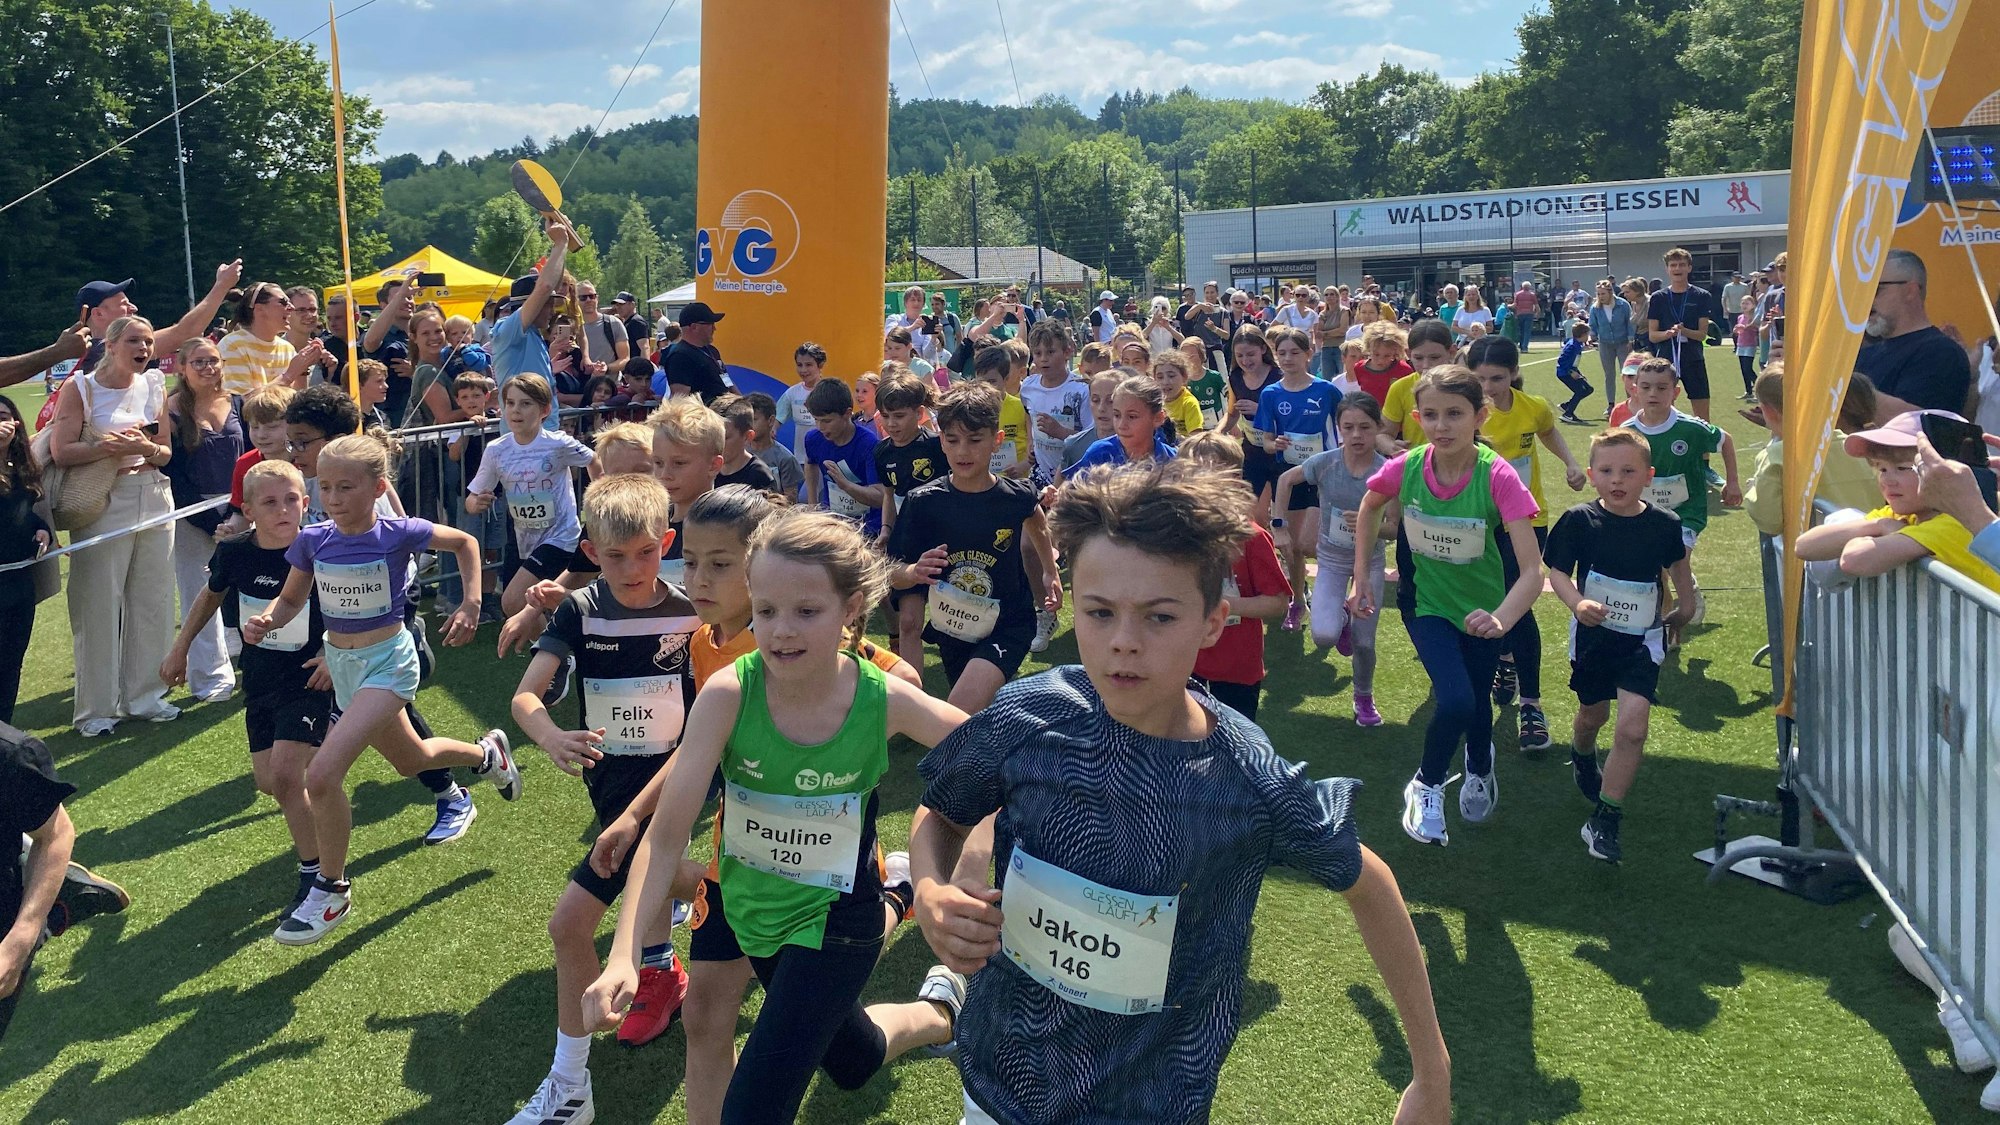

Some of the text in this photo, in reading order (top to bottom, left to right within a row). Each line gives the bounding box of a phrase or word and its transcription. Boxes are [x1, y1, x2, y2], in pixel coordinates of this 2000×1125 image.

[1388, 187, 1700, 225] WALDSTADION GLESSEN
[697, 227, 777, 276] GVG
[1271, 264, 1315, 273] Waldstadion
[714, 279, 787, 296] Meine Energie.
[1294, 444, 1314, 452] Clara
[1651, 488, 1672, 496] Felix
[513, 504, 547, 519] 1423
[1423, 530, 1461, 545] Luise
[1433, 545, 1450, 555] 121
[967, 550, 998, 568] GLESSEN
[320, 580, 382, 595] Weronika
[340, 598, 360, 607] 274
[1605, 595, 1638, 611] Leon
[938, 601, 980, 622] Matteo
[1610, 611, 1629, 622] 273
[946, 618, 964, 630] 418
[586, 641, 619, 652] uhlsport
[612, 706, 654, 721] Felix
[620, 727, 645, 739] 415
[798, 774, 818, 786] TS
[794, 801, 832, 810] GLESSEN
[746, 818, 832, 846] Pauline
[770, 848, 802, 865] 120
[1082, 887, 1135, 911] GLESSEN
[1028, 907, 1121, 959] Jakob
[1049, 949, 1090, 980] 146
[1058, 981, 1088, 999] bunert
